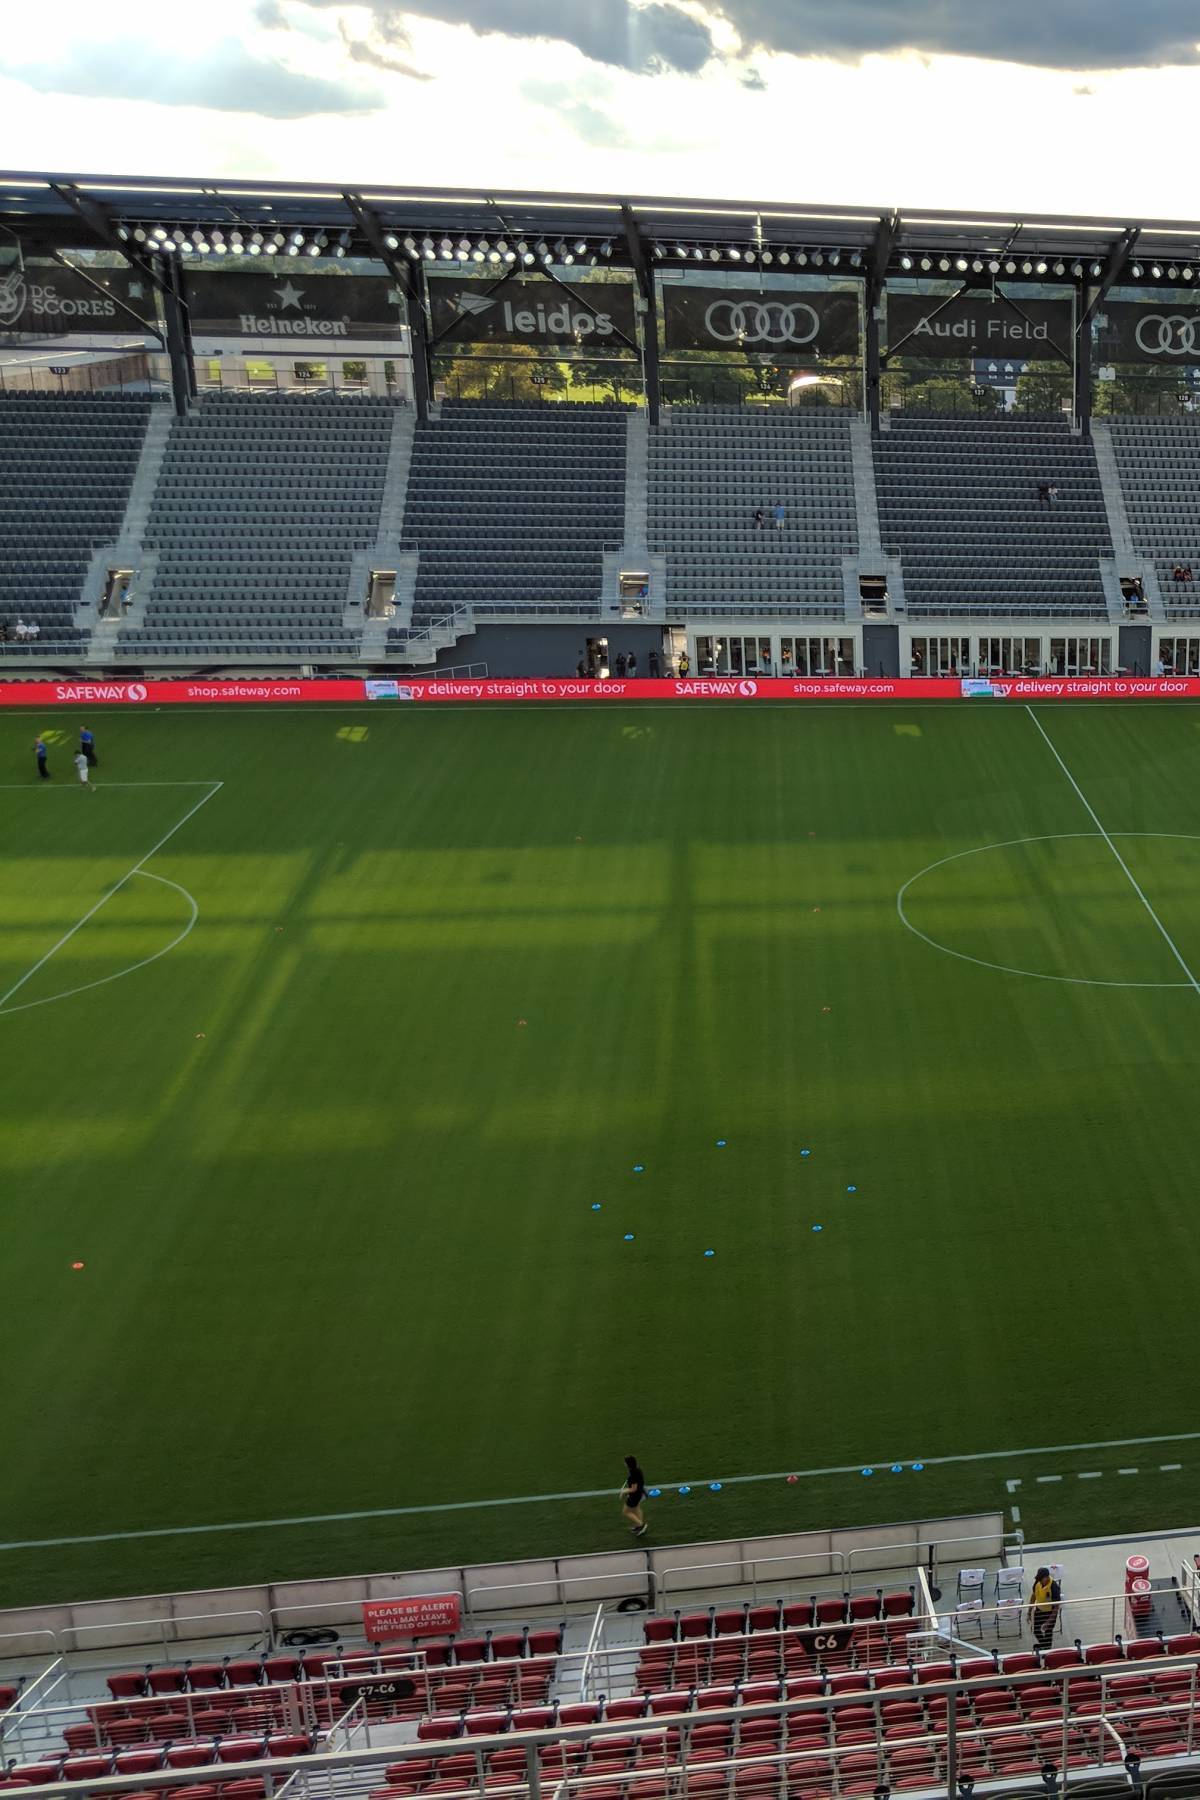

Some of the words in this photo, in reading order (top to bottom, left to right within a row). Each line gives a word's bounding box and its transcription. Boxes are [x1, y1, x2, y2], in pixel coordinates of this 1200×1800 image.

[31, 285, 56, 299] DC
[31, 299, 116, 316] SCORES
[239, 314, 348, 335] Heineken
[503, 301, 614, 335] leidos
[913, 316, 976, 338] Audi
[987, 319, 1048, 340] Field
[53, 366, 66, 374] 123
[56, 686, 125, 700] SAFEWAY
[187, 685, 301, 699] shop.safeway.com
[428, 683, 483, 698] delivery
[487, 681, 538, 697] straight
[541, 682, 556, 694] to
[559, 683, 591, 697] your
[594, 682, 627, 694] door
[674, 682, 737, 695] SAFEWAY
[793, 682, 895, 696] shop.safeway.com
[1015, 681, 1064, 696] delivery
[1066, 681, 1111, 695] straight
[1114, 682, 1127, 692] to
[1129, 683, 1158, 695] your
[1159, 681, 1188, 692] door
[368, 1607, 405, 1617] PLEASE
[405, 1605, 418, 1613] BE
[421, 1602, 454, 1612] ALERT!
[400, 1615, 419, 1623] MAY
[421, 1613, 447, 1621] LEAVE
[371, 1624, 389, 1632] THE
[390, 1622, 415, 1631] FIELD
[814, 1634, 838, 1650] C6
[358, 1683, 396, 1696] C7-C6
